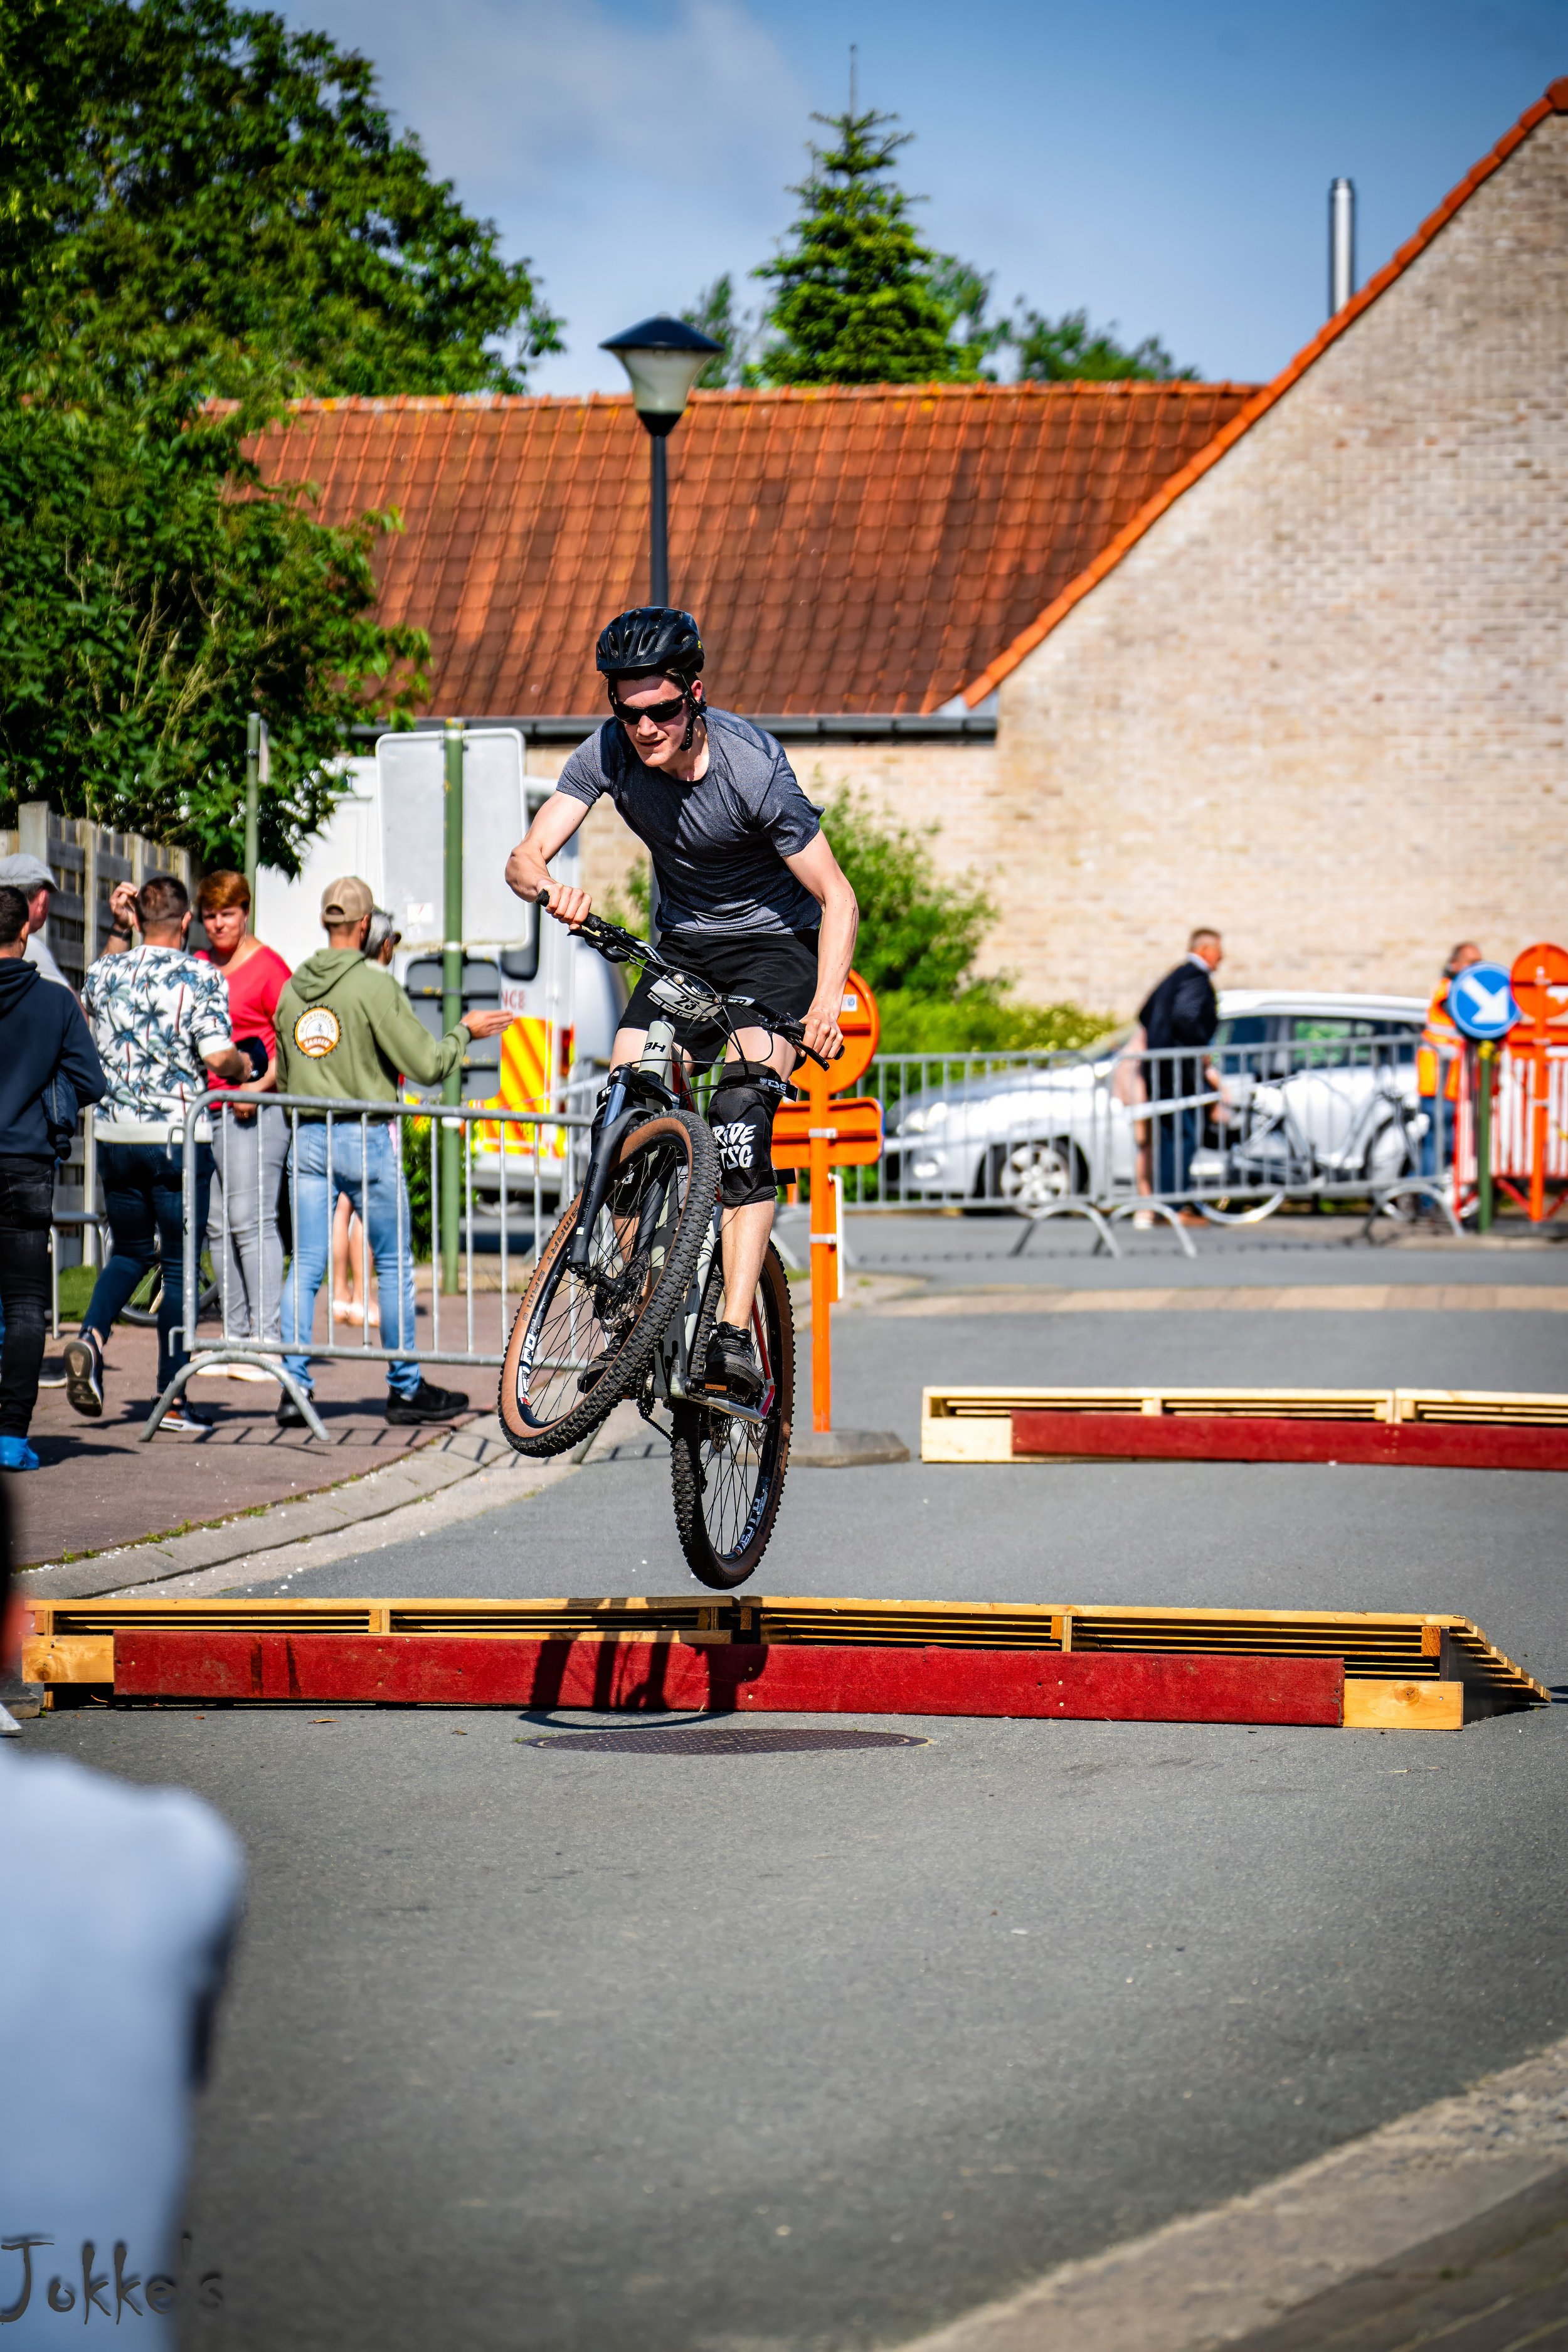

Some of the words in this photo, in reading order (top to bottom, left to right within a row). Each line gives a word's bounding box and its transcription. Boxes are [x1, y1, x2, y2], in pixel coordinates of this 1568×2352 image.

[674, 995, 700, 1010] 23
[644, 1042, 666, 1052] BH
[548, 1205, 578, 1265] SMART
[527, 1269, 546, 1308] SAM
